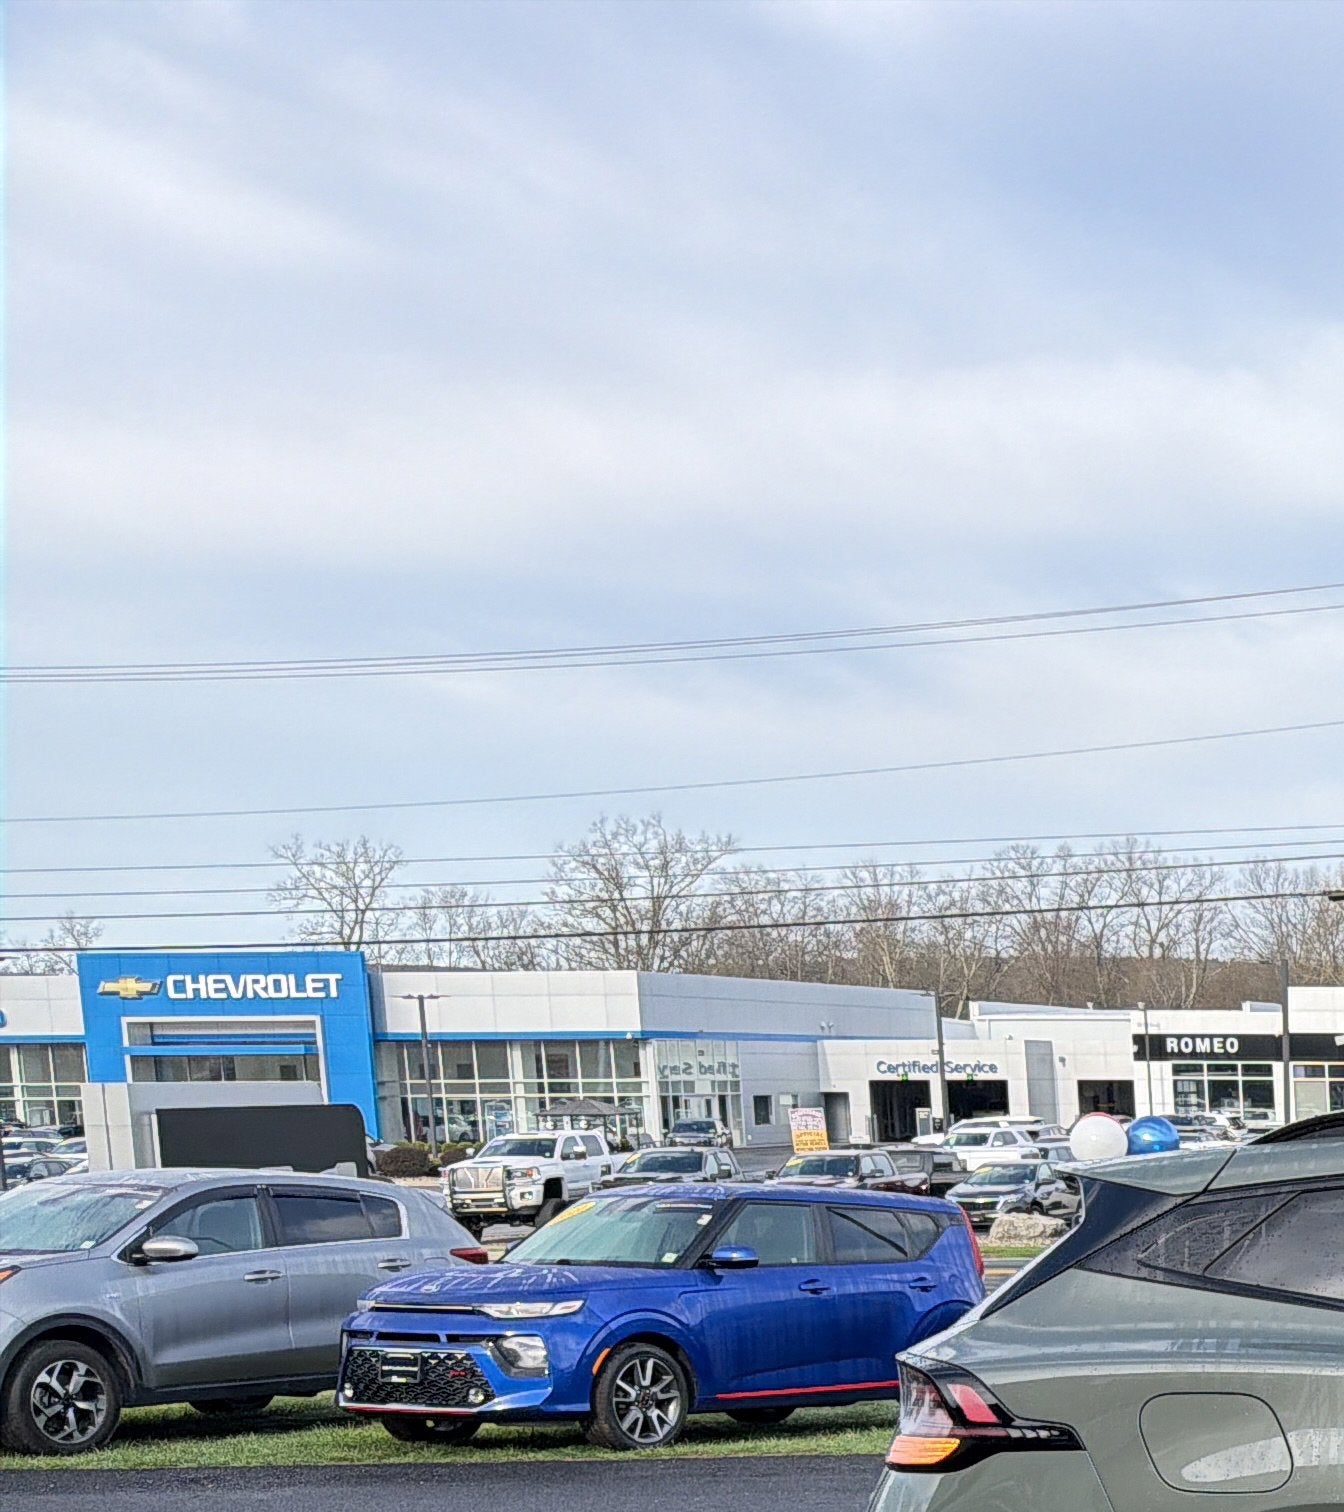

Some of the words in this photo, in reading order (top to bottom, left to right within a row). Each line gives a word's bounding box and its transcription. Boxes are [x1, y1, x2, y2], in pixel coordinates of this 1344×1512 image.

[166, 973, 343, 999] CHEVROLET
[1165, 1037, 1239, 1053] ROMEO
[876, 1060, 939, 1074] Certified
[944, 1060, 998, 1074] Service
